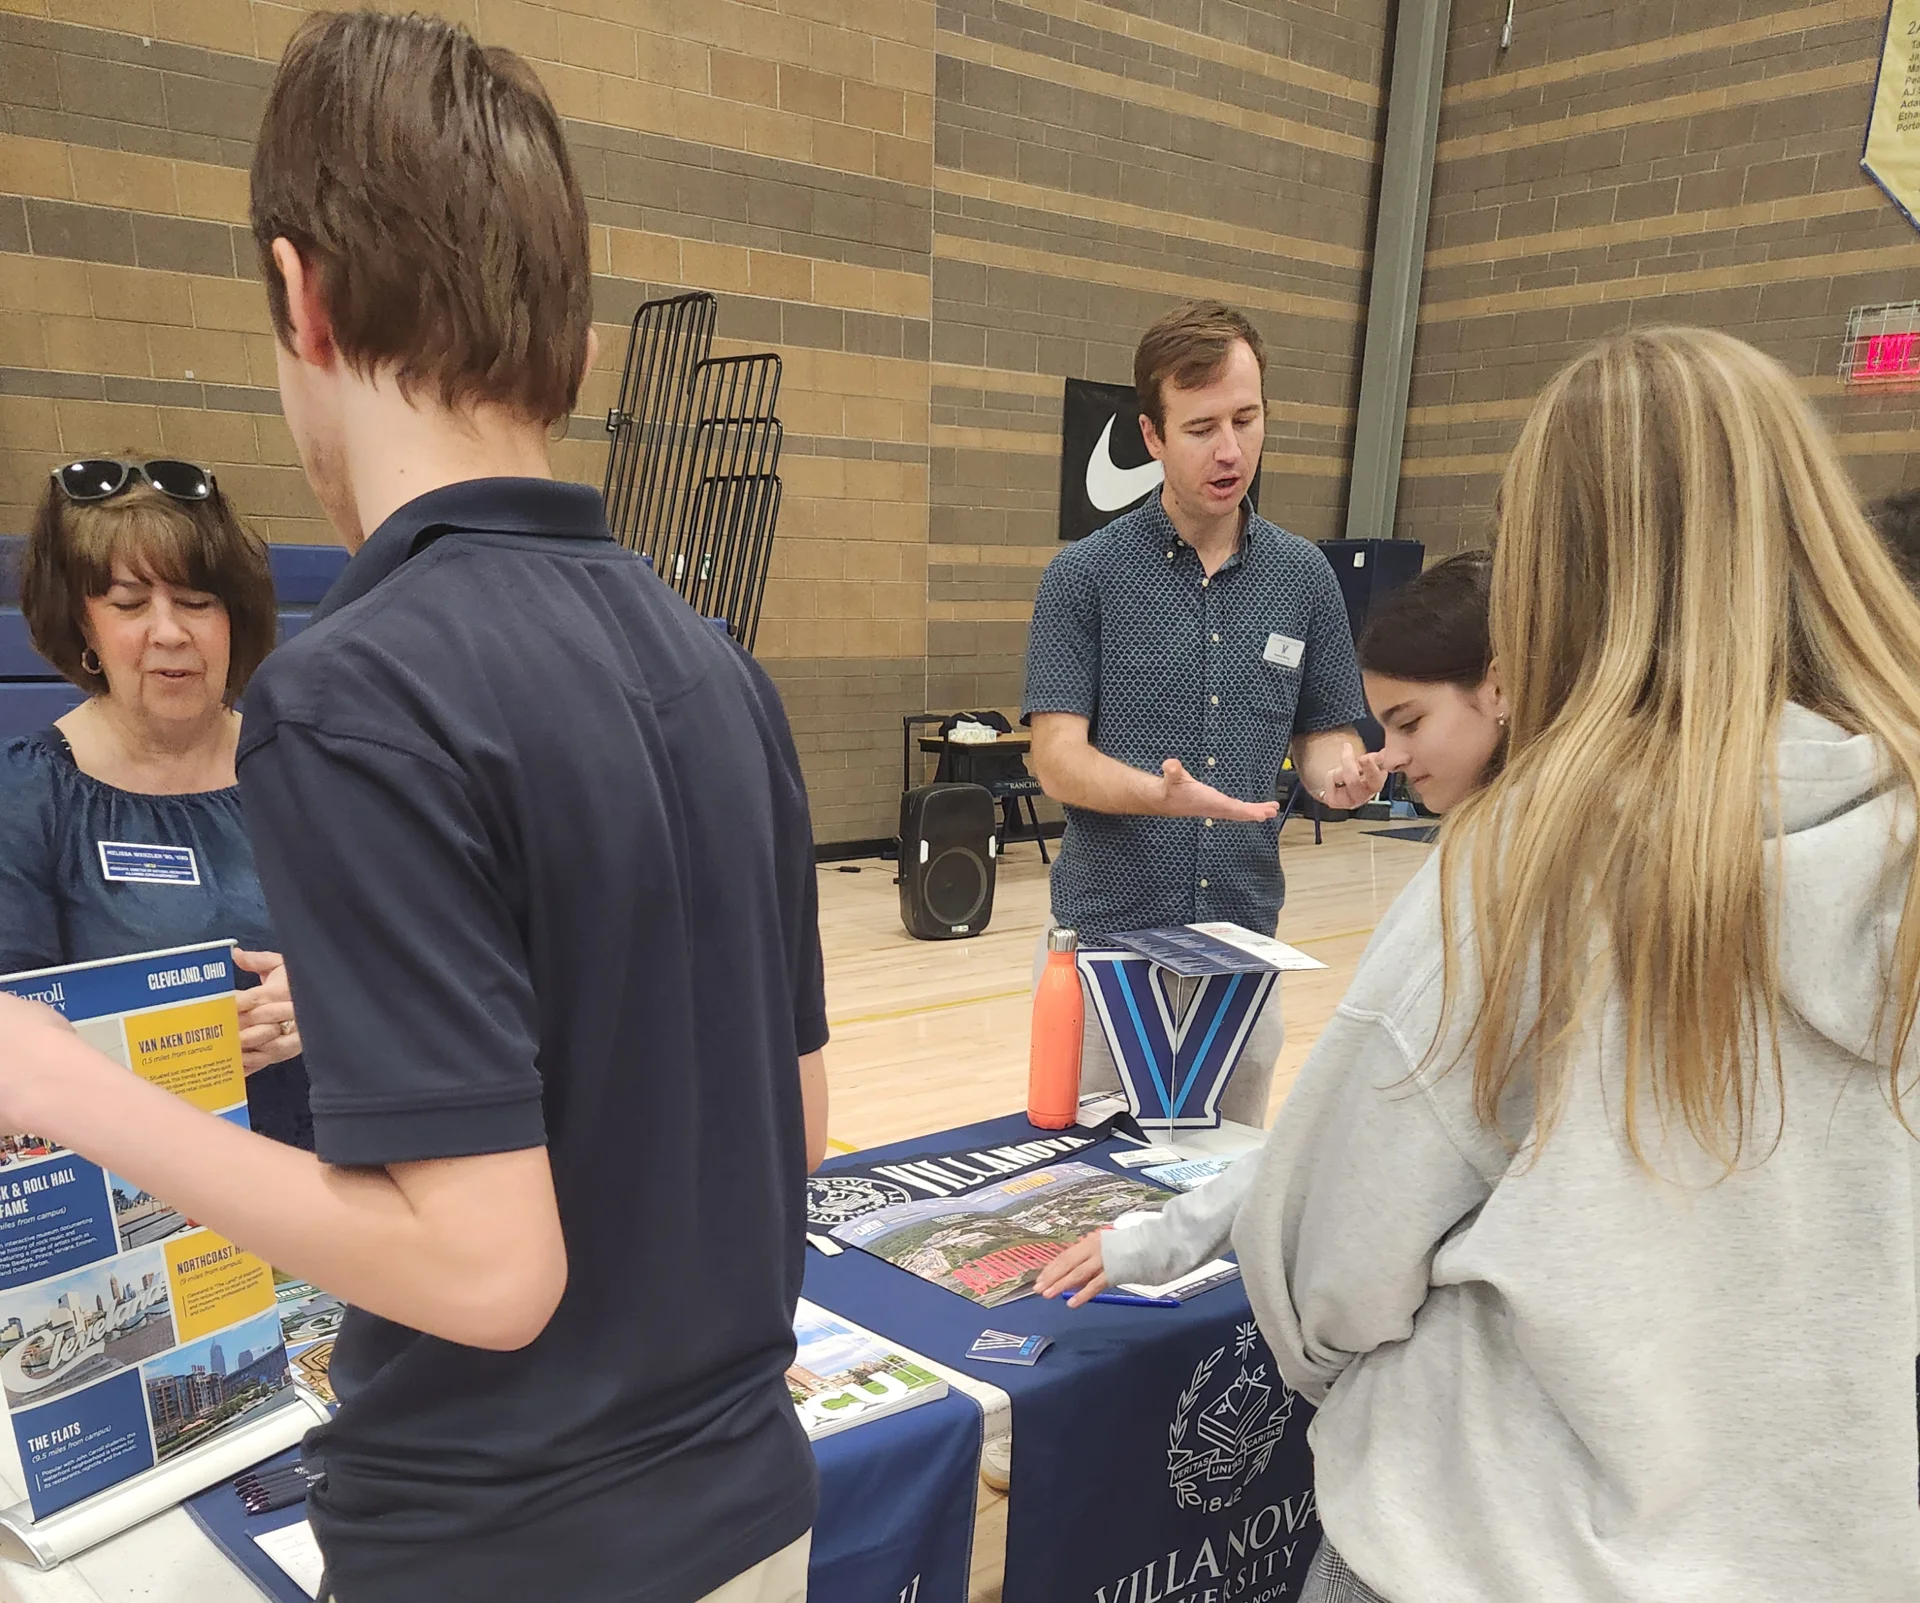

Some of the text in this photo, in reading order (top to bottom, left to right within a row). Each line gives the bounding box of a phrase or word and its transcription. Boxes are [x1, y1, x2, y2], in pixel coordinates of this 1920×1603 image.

[1898, 112, 1920, 122] Etha
[1900, 100, 1920, 110] Ada
[1866, 334, 1916, 371] EXIT
[1010, 780, 1041, 790] RANCHO
[147, 961, 226, 990] CLEVELAND, OHIO
[138, 1024, 224, 1054] VAN AKEN DISTRICT
[154, 1054, 170, 1063] miles
[172, 1050, 186, 1058] from
[870, 1135, 1096, 1198] VILLANOVA
[12, 1182, 22, 1198] &
[22, 1175, 50, 1195] ROLL
[50, 1168, 76, 1187] HALL
[0, 1198, 29, 1219] FAME
[17, 1216, 36, 1226] from
[36, 1206, 67, 1221] campus)
[4, 1235, 36, 1248] interactive
[36, 1228, 60, 1239] museum
[60, 1217, 94, 1231] documenting
[7, 1244, 28, 1255] history
[36, 1237, 48, 1246] rock
[49, 1234, 64, 1243] music
[0, 1250, 24, 1263] eaturing
[30, 1246, 46, 1256] range
[54, 1238, 70, 1248] artists
[36, 1251, 54, 1262] Prince,
[177, 1246, 232, 1276] NORTHCOAST
[12, 1265, 28, 1274] Dolly
[188, 1273, 204, 1282] miles
[204, 1268, 218, 1276] from
[27, 1422, 81, 1453] THE FLATS
[32, 1424, 112, 1464] (9.5 miles from campus)
[1247, 1426, 1281, 1449] CARITAS
[42, 1432, 136, 1477] Popular with John Carroll students, the
[42, 1468, 70, 1483] waterfront
[71, 1450, 106, 1472] neighborhood
[111, 1442, 126, 1453] known
[1212, 1456, 1243, 1475] UNITAS
[52, 1470, 82, 1486] restaurants,
[113, 1450, 122, 1458] live
[1174, 1457, 1210, 1481] VERITAS
[1094, 1489, 1321, 1603] VILLANOVA
